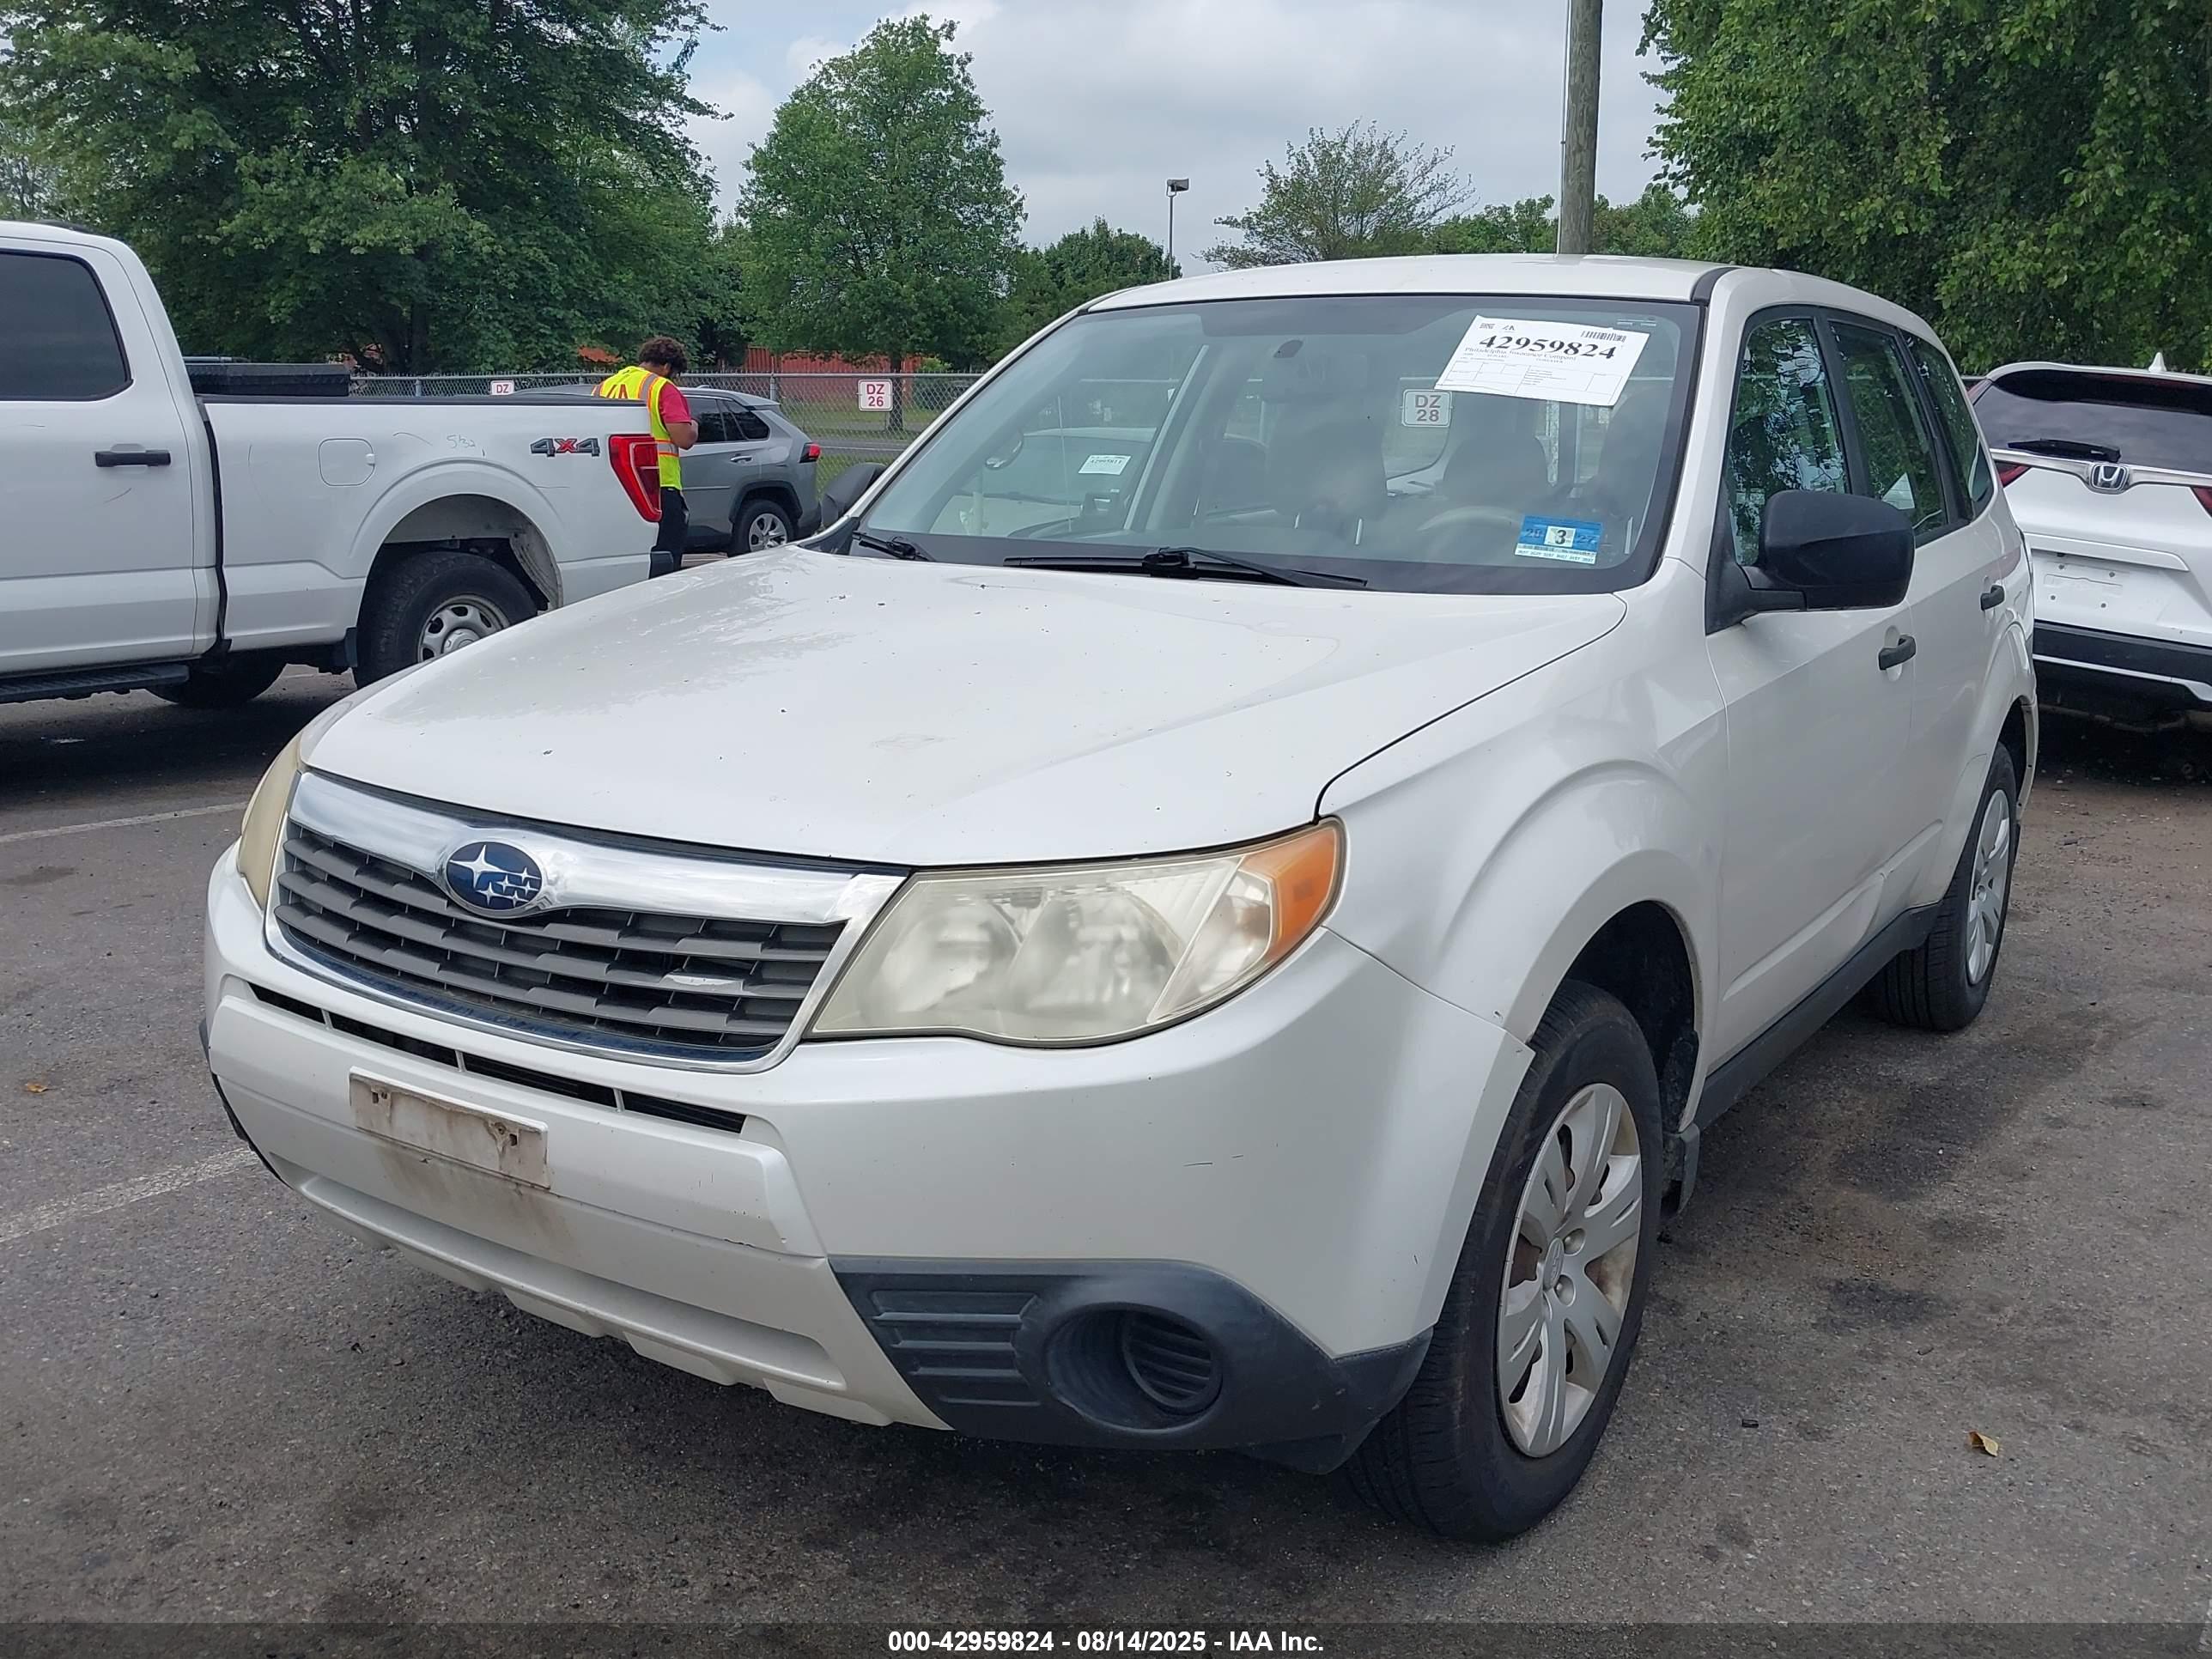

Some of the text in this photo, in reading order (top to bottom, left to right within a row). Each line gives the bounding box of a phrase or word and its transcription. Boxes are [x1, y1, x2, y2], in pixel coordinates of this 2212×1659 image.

[1480, 335, 1617, 359] 42959824
[496, 384, 509, 393] DZ
[866, 384, 884, 395] DZ
[868, 396, 884, 407] 26
[1415, 395, 1442, 408] DZ
[1417, 409, 1439, 422] 28
[1555, 529, 1567, 545] 3
